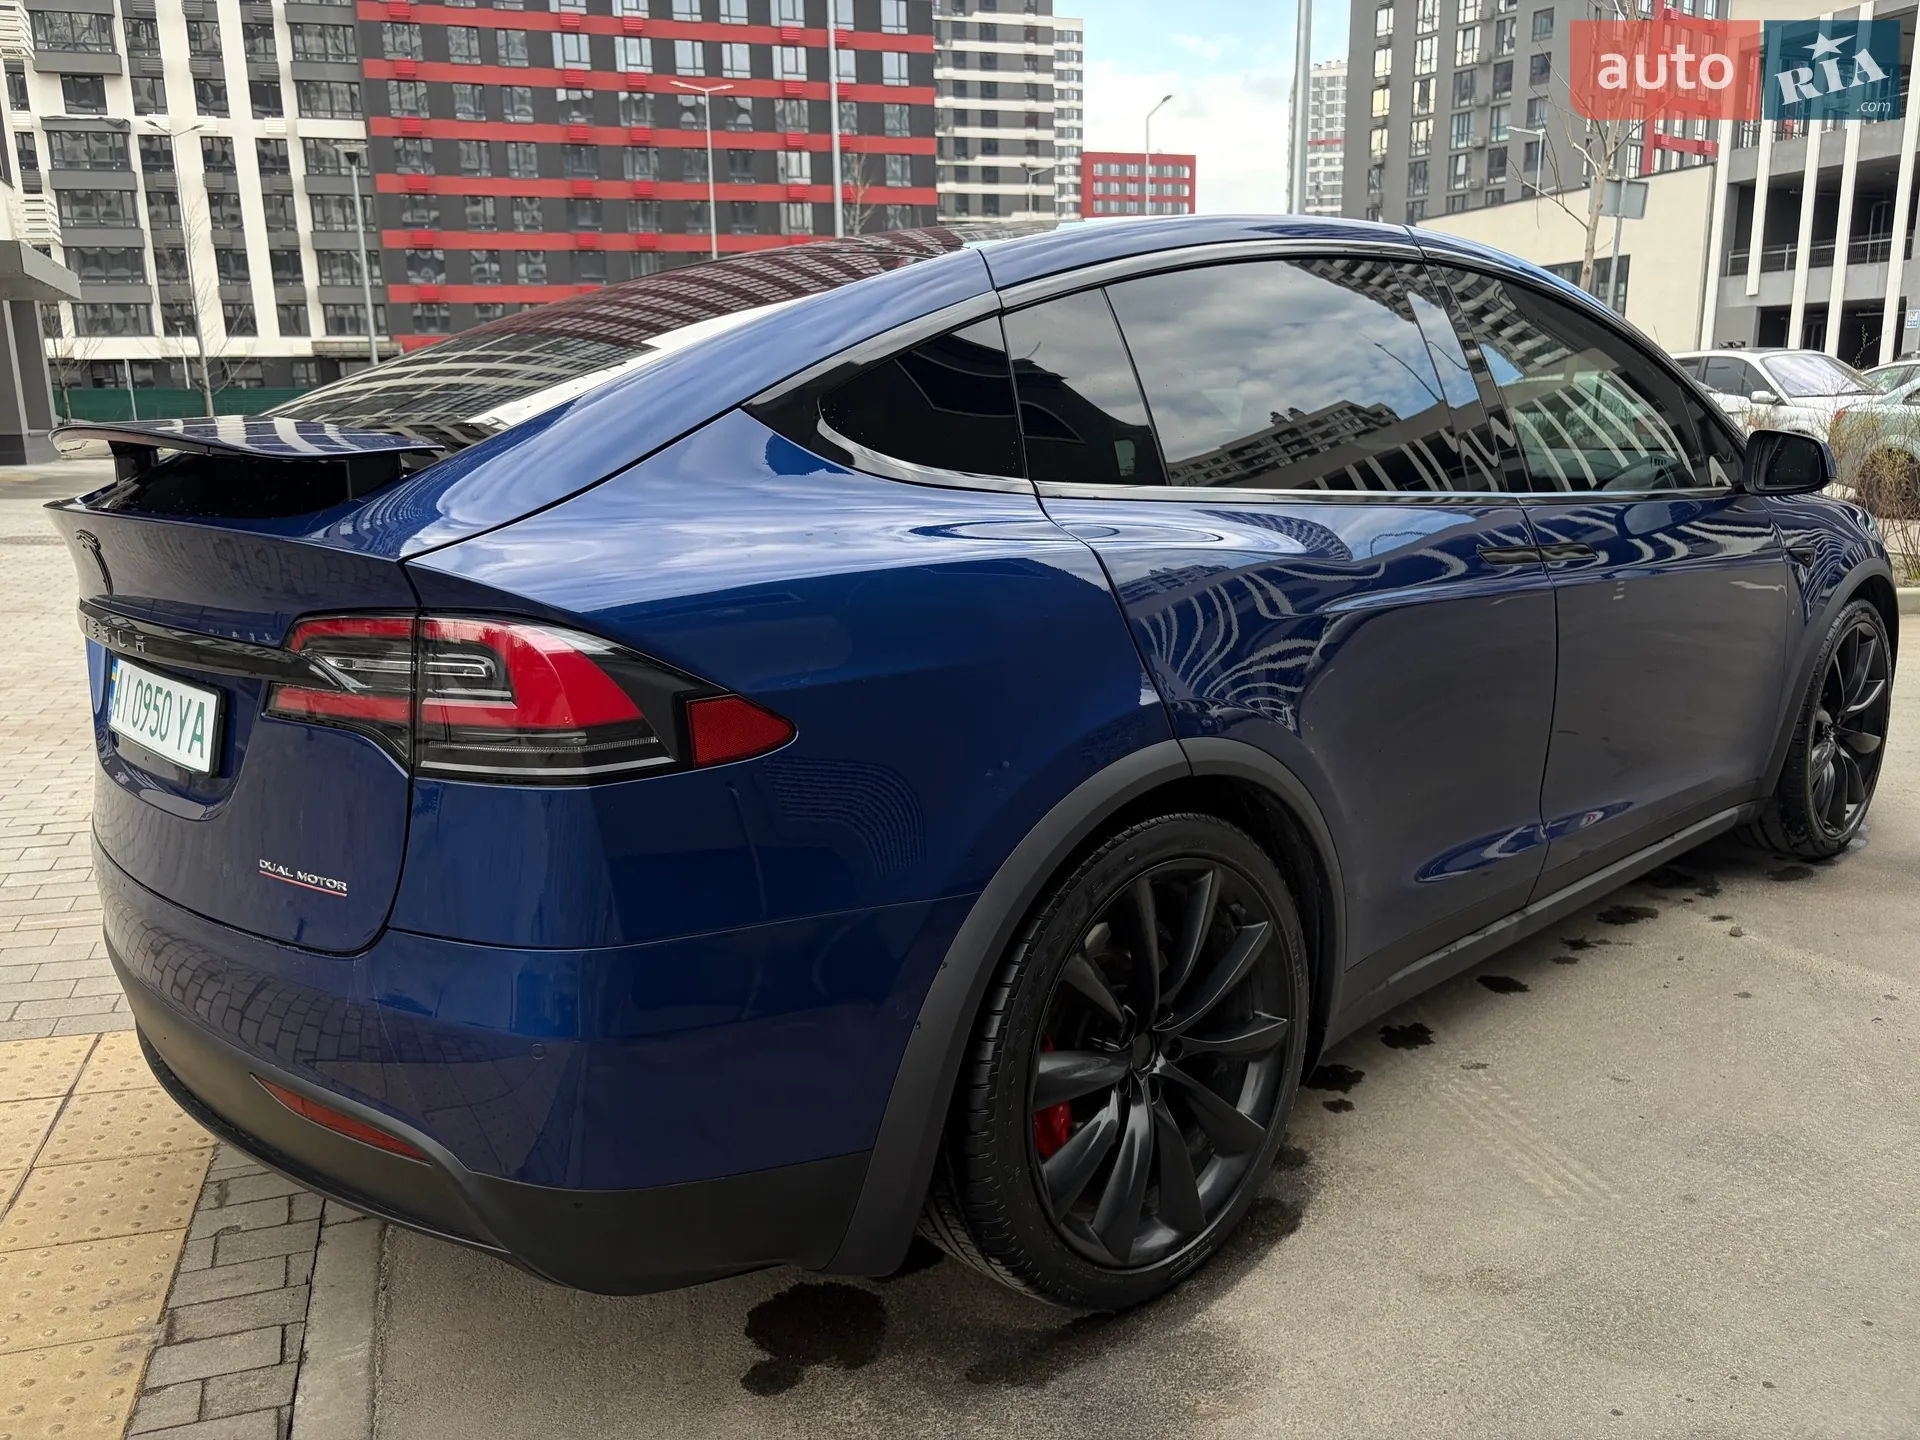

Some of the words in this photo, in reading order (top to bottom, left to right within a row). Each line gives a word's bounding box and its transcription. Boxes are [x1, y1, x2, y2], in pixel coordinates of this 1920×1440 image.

[84, 616, 146, 653] TESLA
[113, 668, 131, 723] AI
[132, 678, 173, 742] 0950
[177, 695, 205, 759] YA
[259, 859, 294, 877] DUAL
[297, 870, 348, 891] MOTOR
